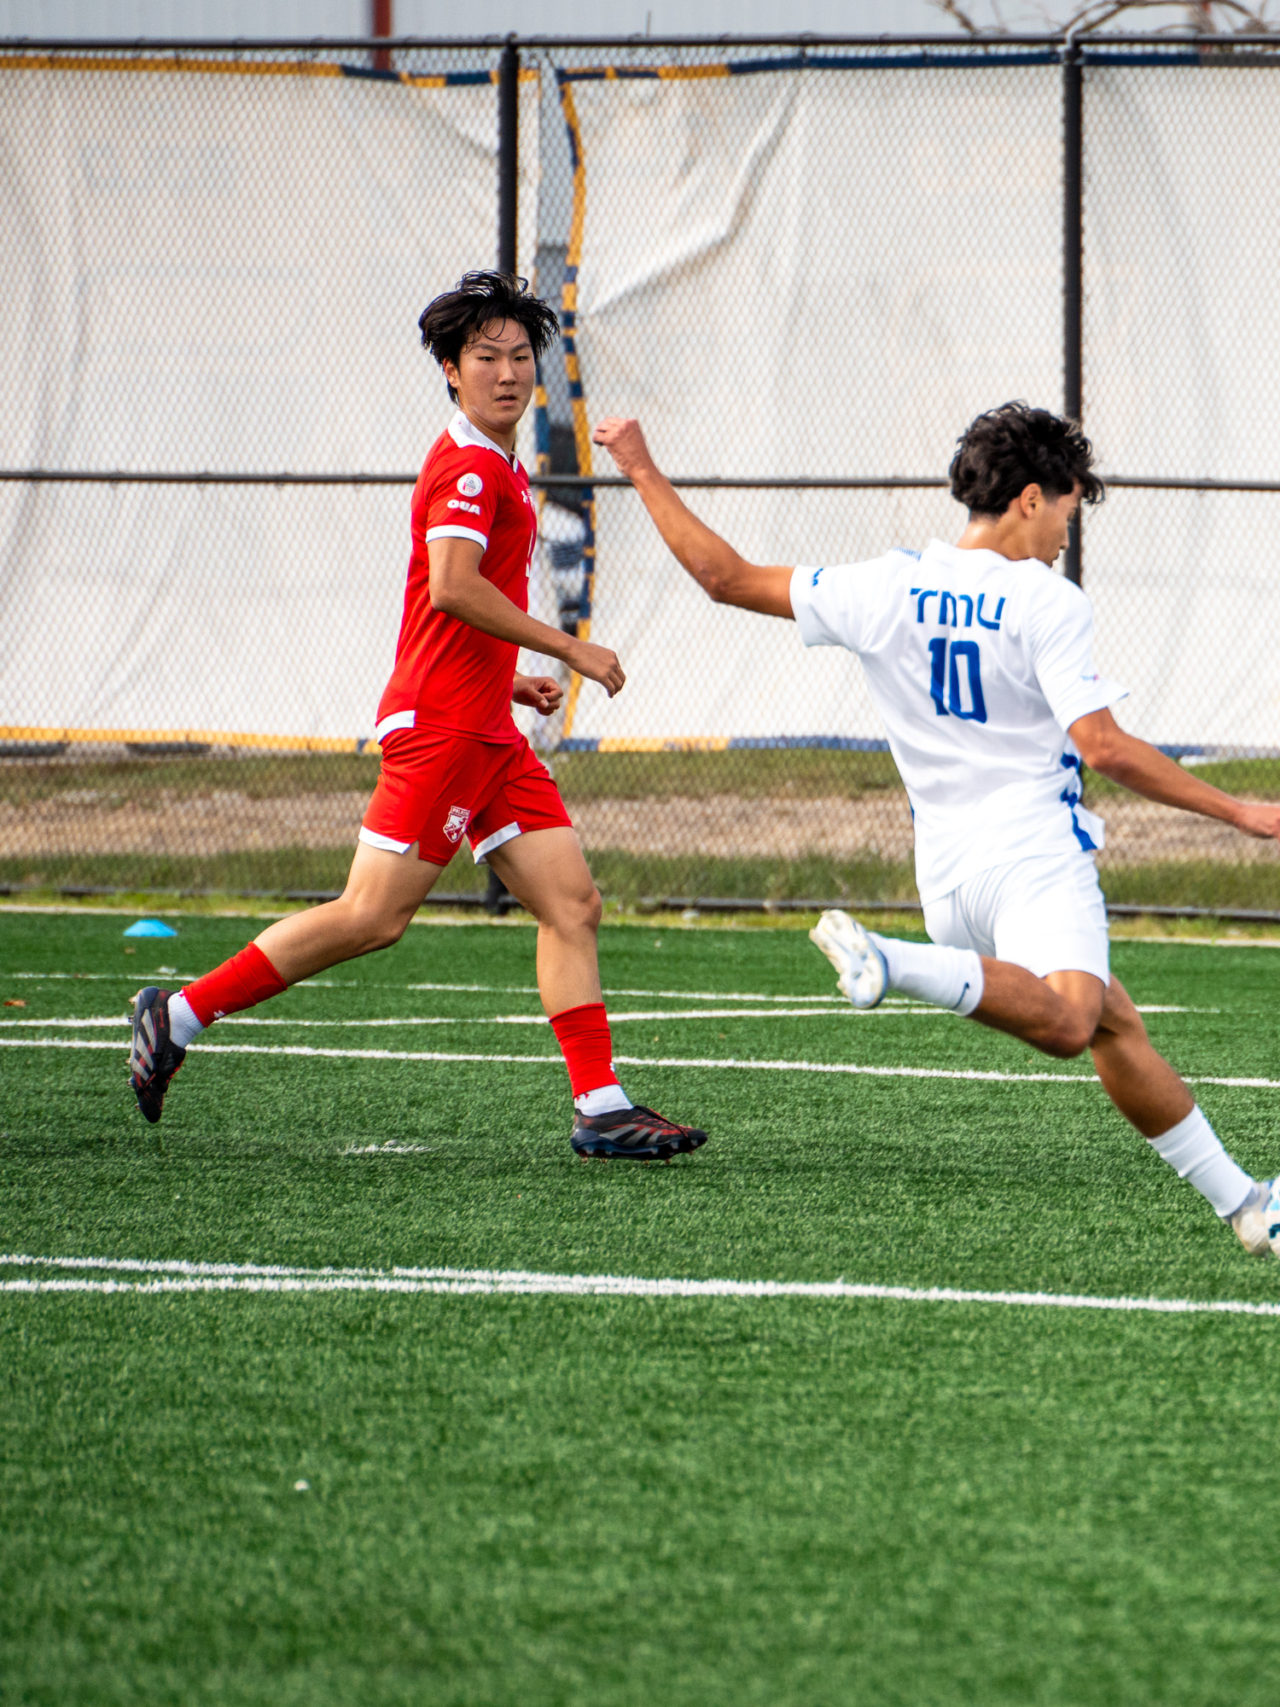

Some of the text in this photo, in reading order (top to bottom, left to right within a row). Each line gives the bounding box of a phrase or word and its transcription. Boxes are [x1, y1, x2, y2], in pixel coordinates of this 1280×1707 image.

[447, 499, 481, 516] OUA
[909, 587, 1006, 631] TMU
[928, 637, 988, 725] 10
